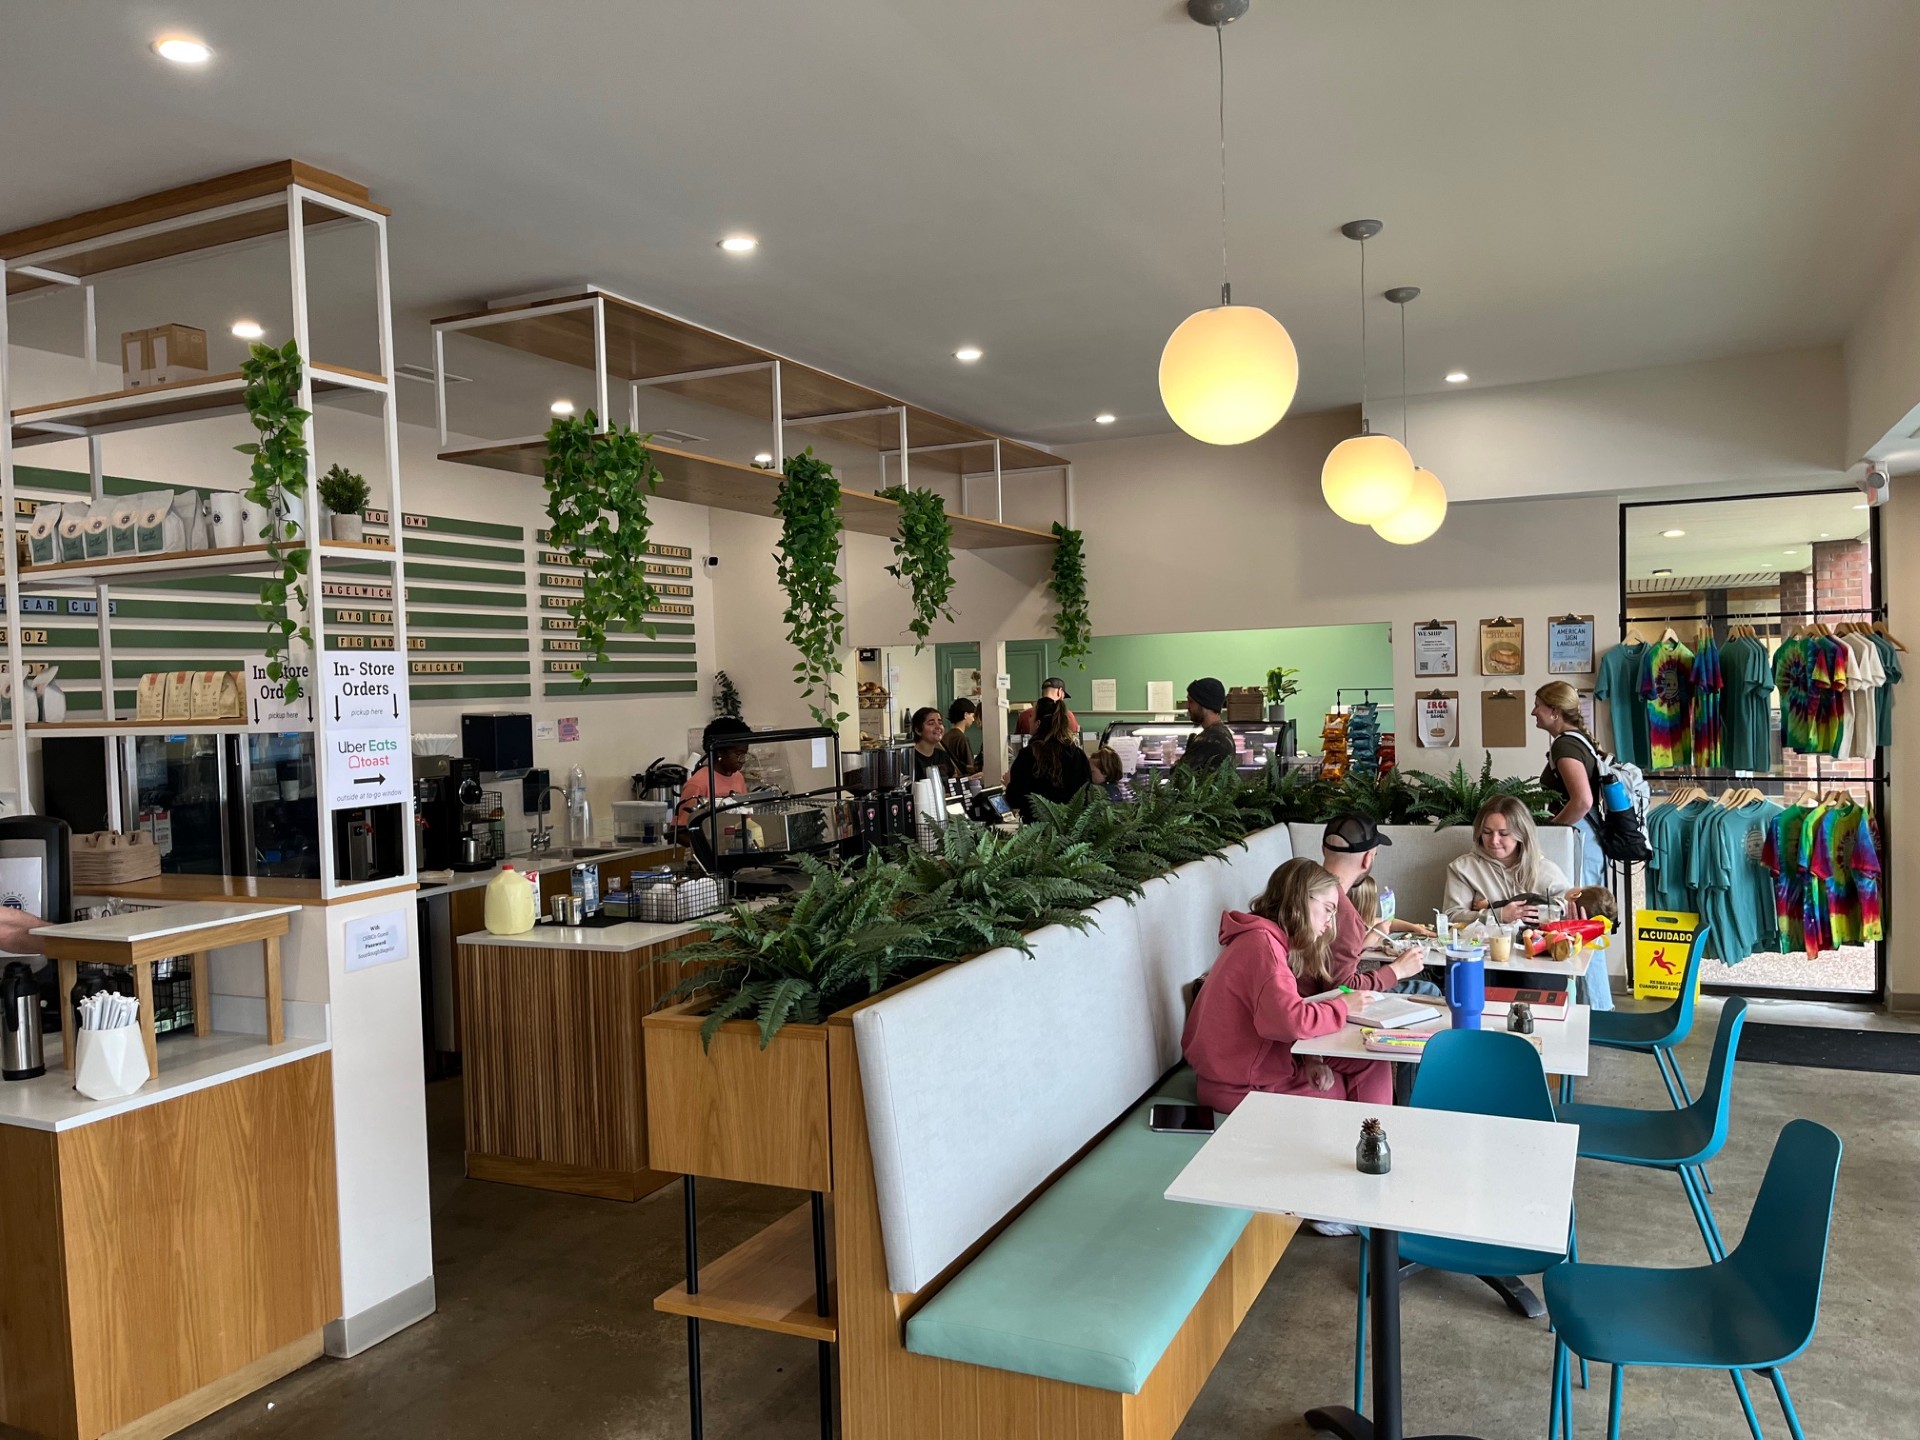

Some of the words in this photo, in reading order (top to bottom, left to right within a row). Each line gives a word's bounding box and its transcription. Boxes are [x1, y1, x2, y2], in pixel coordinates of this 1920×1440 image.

[406, 516, 427, 526] OWN
[661, 547, 688, 557] COFFEE
[667, 567, 689, 575] LATTE
[548, 577, 582, 585] DOPPIO
[668, 586, 690, 595] LATTE
[71, 601, 114, 612] CUS
[1486, 631, 1521, 639] CHICKEN
[340, 638, 362, 647] FIG
[373, 639, 393, 648] AND
[551, 641, 579, 650] LATTE
[1556, 640, 1586, 648] LANGUAGE
[279, 664, 308, 679] tore
[359, 661, 395, 676] Store
[414, 663, 462, 672] CHICKEN
[552, 663, 580, 671] CUBAN
[260, 683, 304, 700] Ords
[342, 680, 389, 697] Orders
[268, 711, 286, 720] pickup
[286, 711, 299, 719] here
[350, 709, 370, 717] pickup
[338, 741, 366, 754] Uber
[368, 739, 398, 751] Eats
[361, 755, 389, 768] toast
[336, 793, 359, 802] outside
[359, 792, 366, 800] at
[382, 789, 402, 797] window
[1649, 930, 1693, 942] CUIDADO
